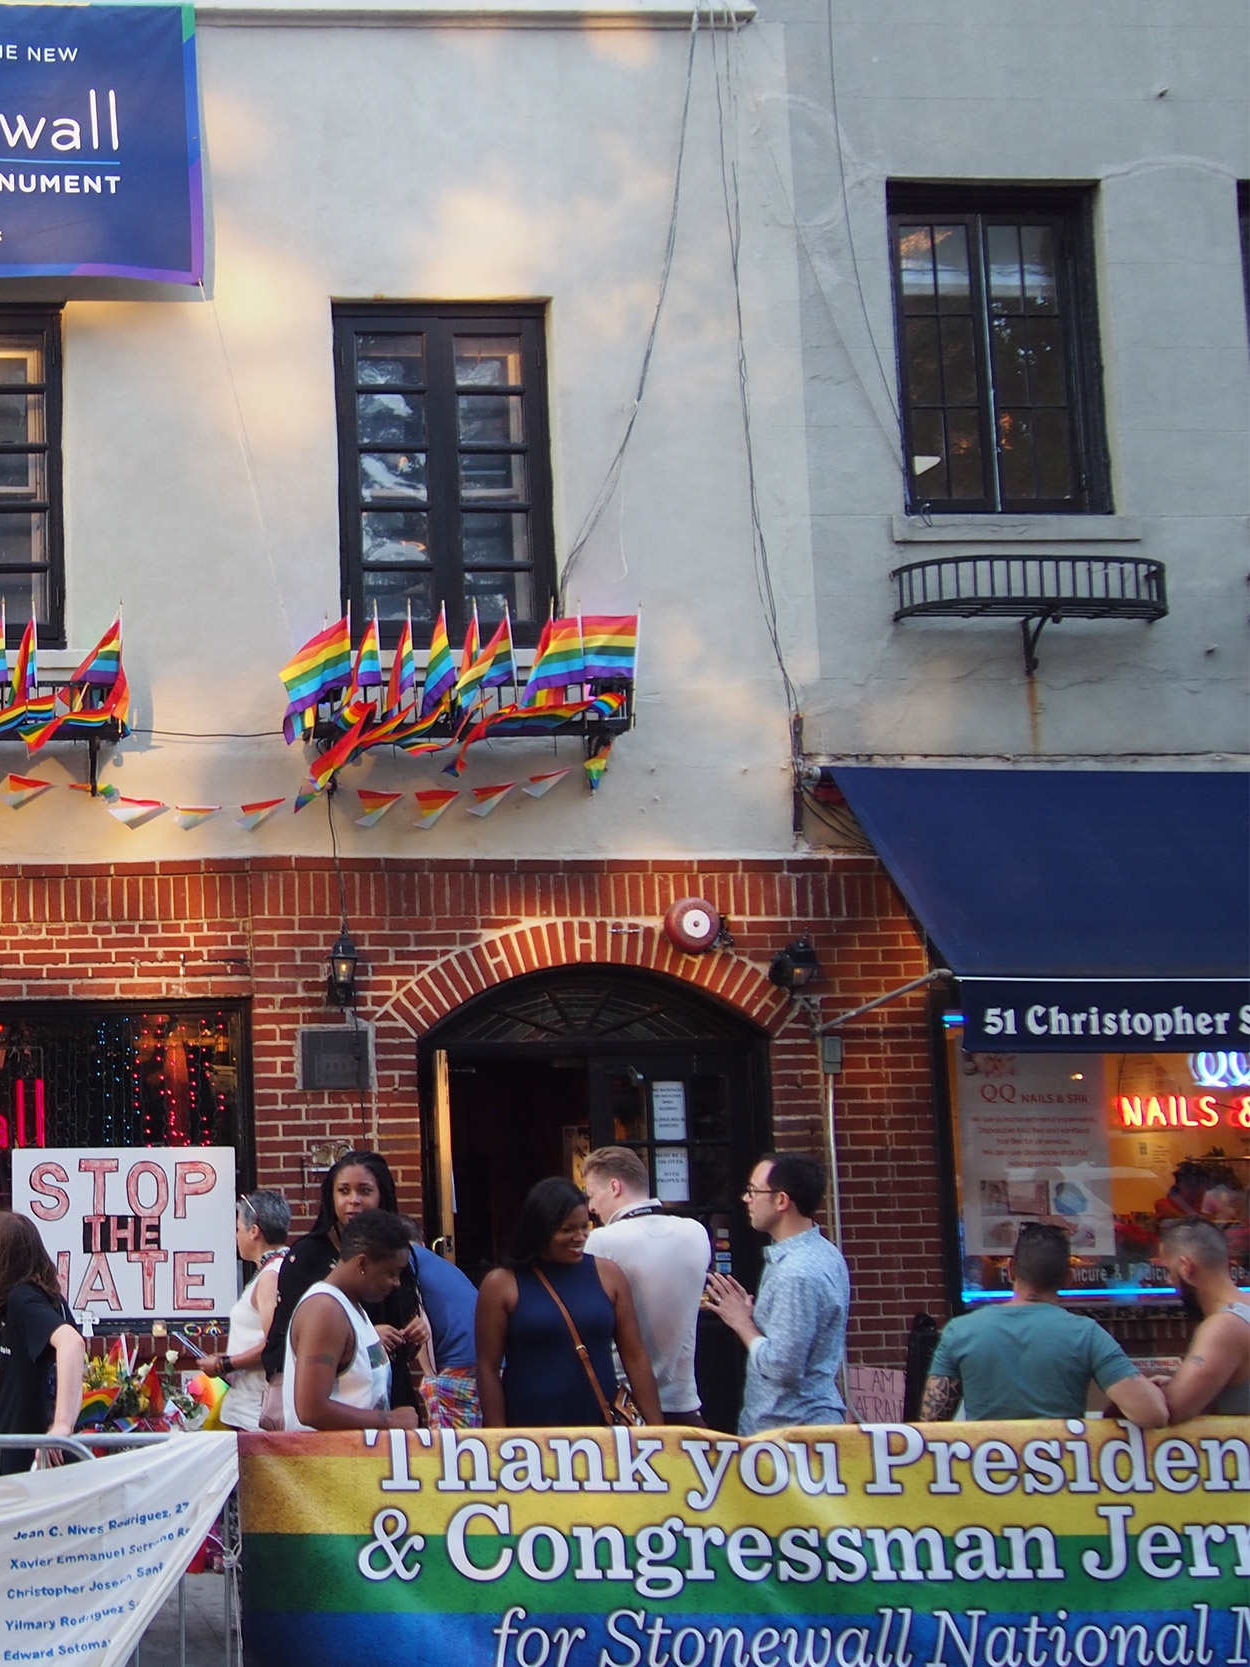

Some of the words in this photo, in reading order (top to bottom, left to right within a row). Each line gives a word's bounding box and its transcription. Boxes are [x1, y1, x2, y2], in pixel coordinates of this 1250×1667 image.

[28, 46, 78, 62] NEW
[984, 1007, 1017, 1035] 51
[1025, 1004, 1230, 1042] Christopher
[981, 1084, 1016, 1103] QQ
[1021, 1094, 1054, 1103] NAILS
[1057, 1094, 1063, 1103] &
[1067, 1094, 1088, 1103] SPA
[1121, 1096, 1219, 1127] NAILS
[29, 1158, 217, 1221] STOP
[83, 1215, 161, 1253] THE
[849, 1367, 865, 1391] I
[872, 1370, 894, 1394] AM
[364, 1426, 669, 1492] Thank
[681, 1438, 846, 1511] you
[860, 1418, 1250, 1495] Presiden
[13, 1530, 44, 1541] Jean
[49, 1526, 63, 1537] C.
[68, 1525, 104, 1535] Nives
[108, 1509, 172, 1531] Rodriguez,
[10, 1557, 54, 1570] Xavier
[57, 1546, 125, 1564] Emmanuel
[129, 1532, 174, 1555] Serrno
[357, 1508, 426, 1582] &
[446, 1502, 1065, 1600] Congressman
[7, 1584, 86, 1600] Christopher
[5, 1620, 56, 1632] Yilmary
[493, 1606, 586, 1667] for
[598, 1606, 912, 1667] Stonewall
[926, 1603, 1213, 1667] National
[4, 1648, 54, 1661] Edward
